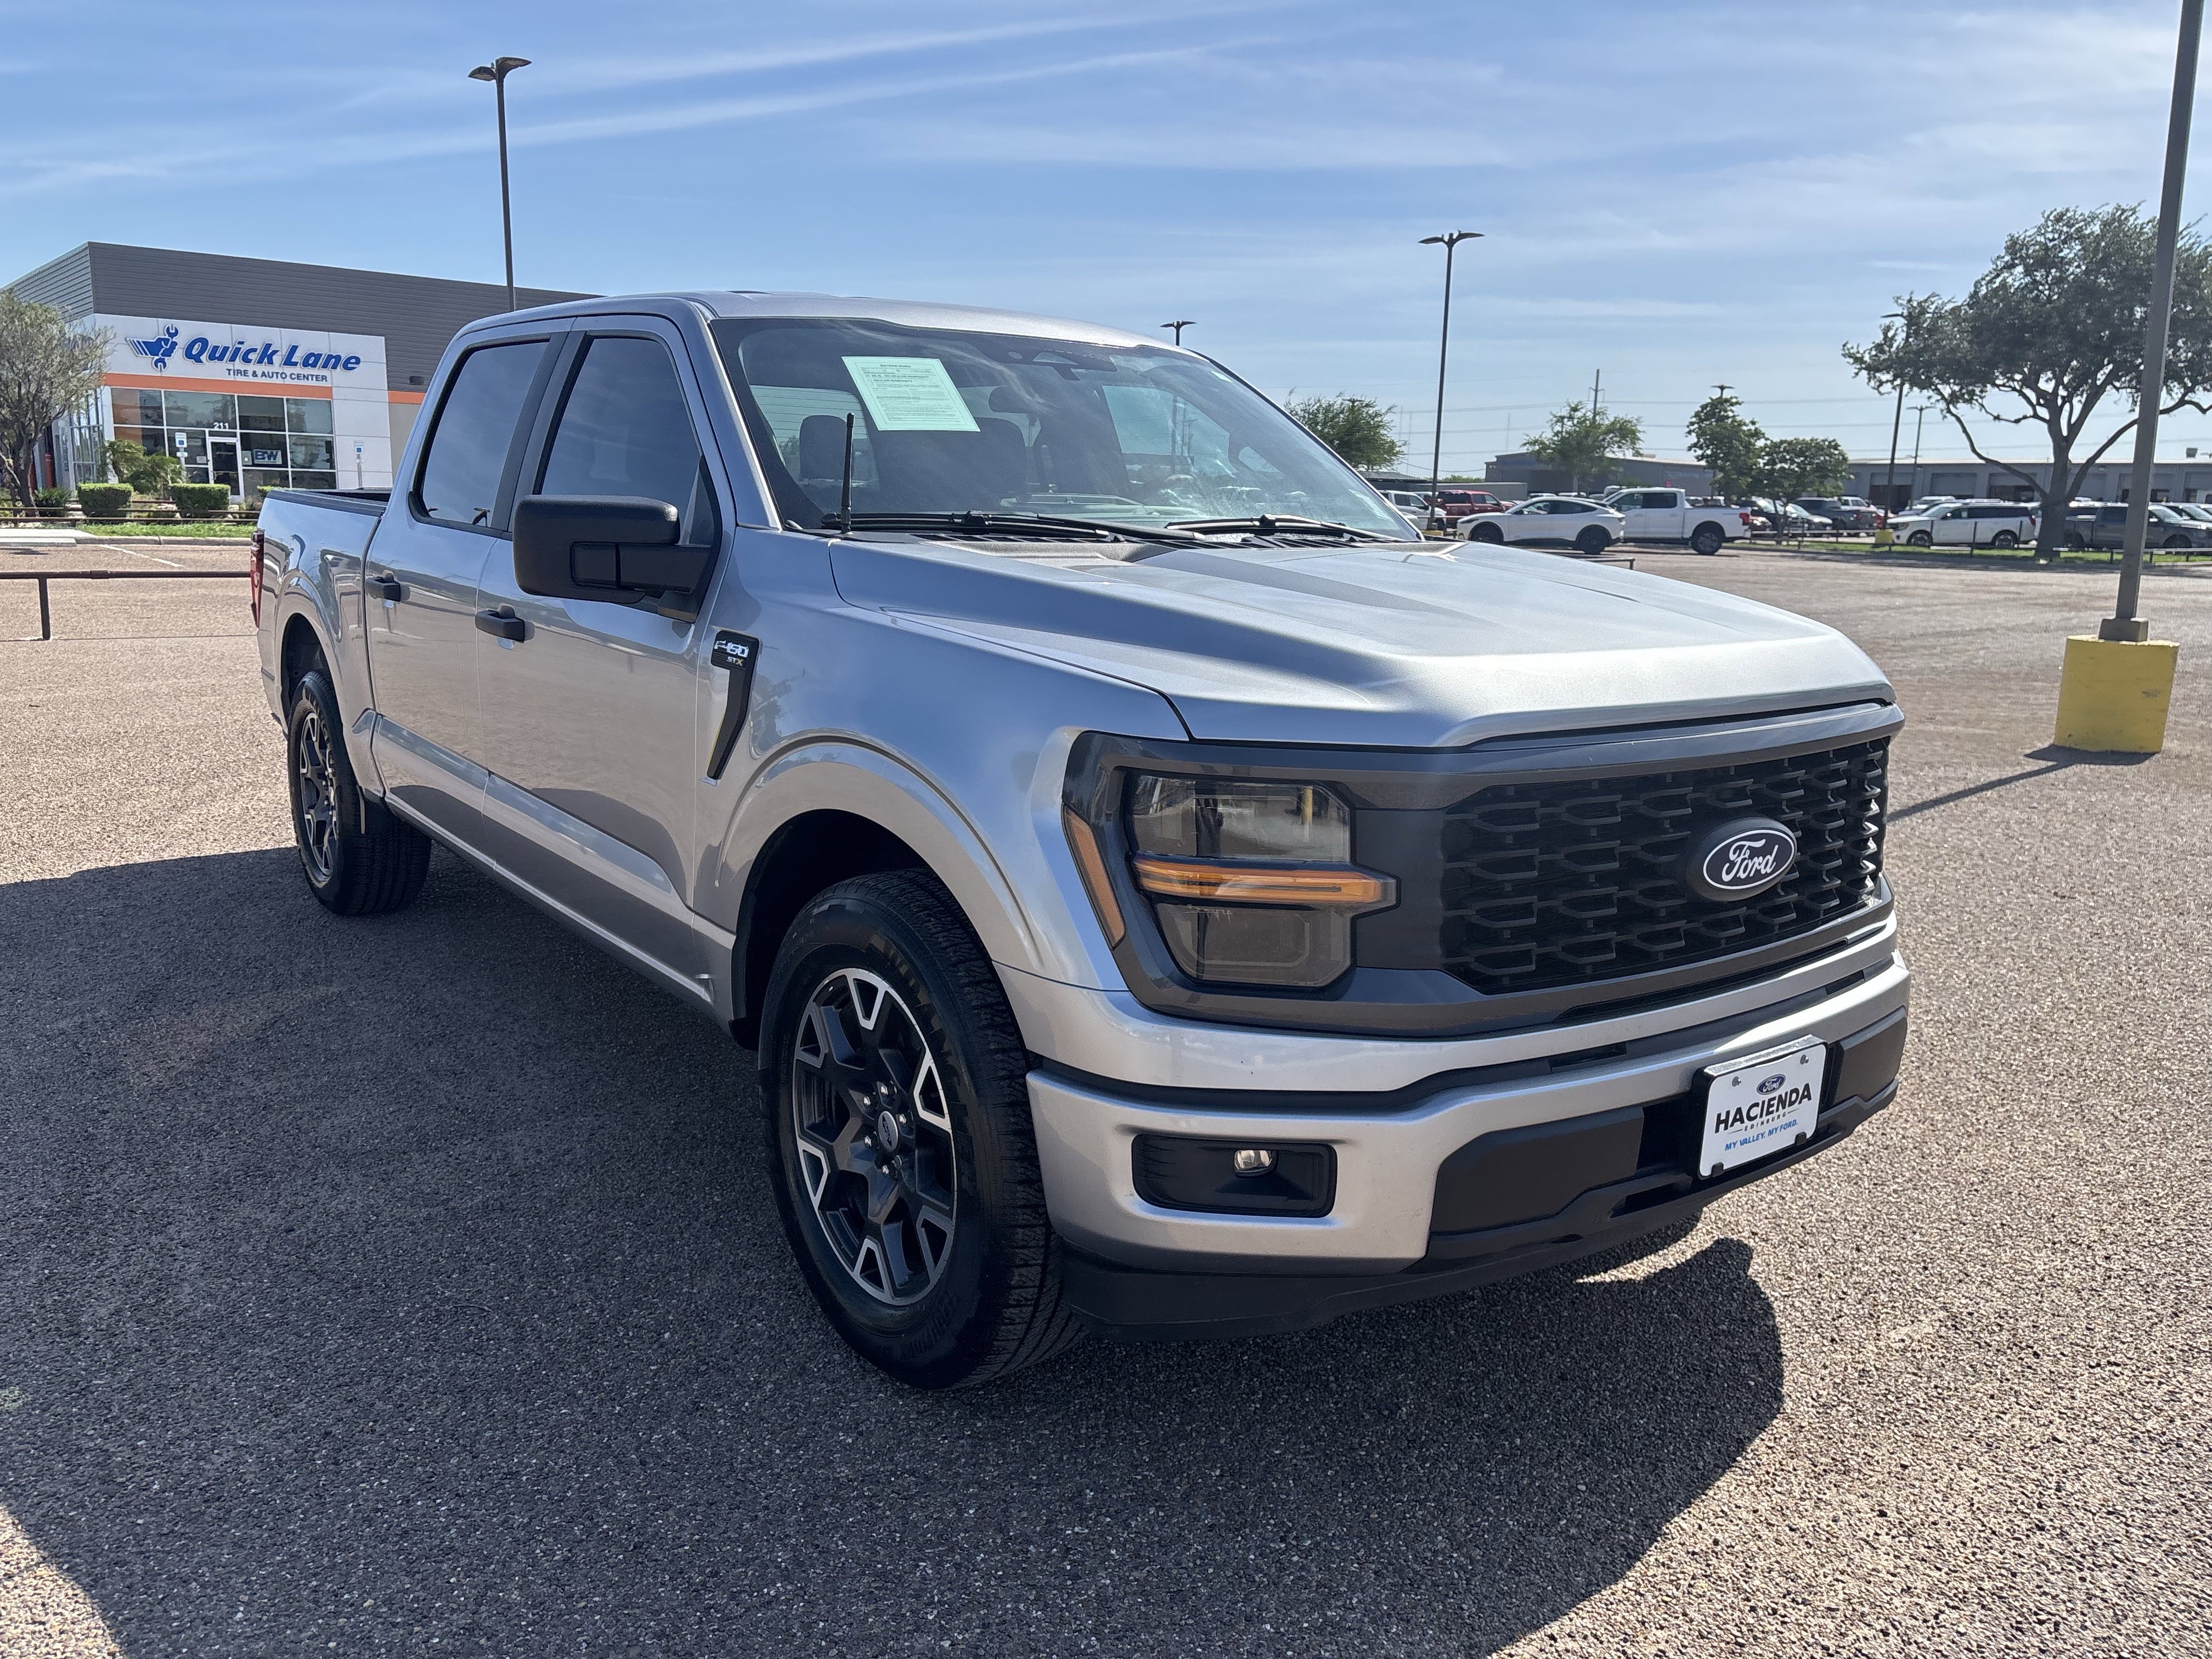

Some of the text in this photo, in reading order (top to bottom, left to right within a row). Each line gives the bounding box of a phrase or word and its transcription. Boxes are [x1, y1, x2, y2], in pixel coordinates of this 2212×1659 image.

[184, 337, 361, 371] Quick Lane
[226, 368, 249, 377] TIRE
[261, 370, 287, 380] AUTO
[289, 373, 328, 382] CENTER
[714, 640, 749, 657] F-150
[726, 656, 744, 666] STX
[1722, 839, 1779, 882] Ford
[1762, 1076, 1781, 1092] Ford
[1714, 1082, 1812, 1133] HACIENDA
[1744, 1111, 1786, 1132] EDINBURG
[1725, 1119, 1798, 1151] MY VALLEY. MY FORD.
